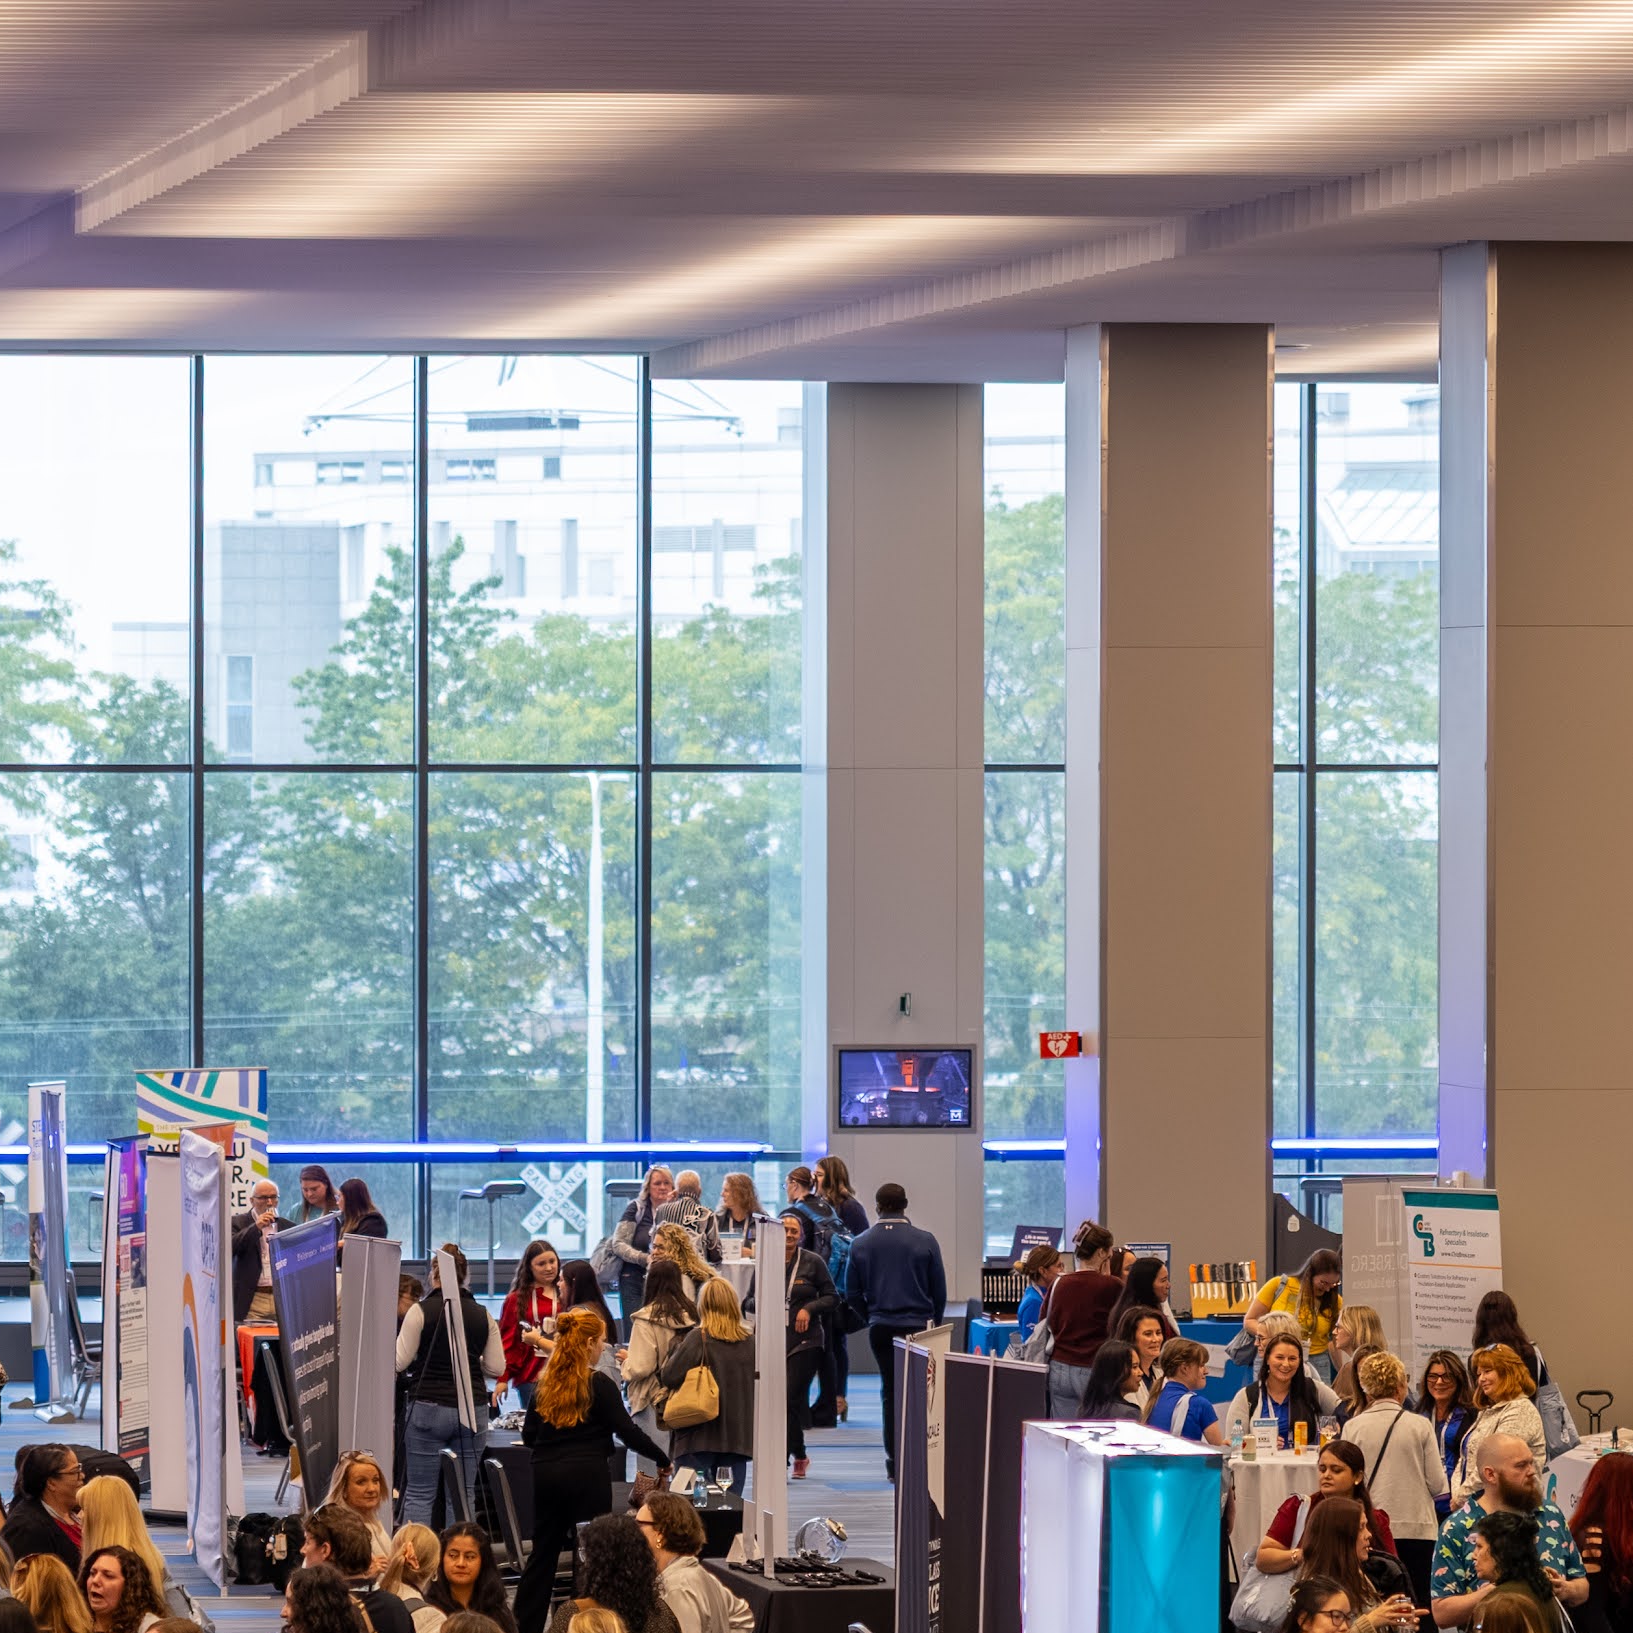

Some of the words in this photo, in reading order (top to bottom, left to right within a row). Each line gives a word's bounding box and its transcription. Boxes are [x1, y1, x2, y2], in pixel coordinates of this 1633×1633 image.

[526, 1168, 548, 1194] RAIL
[528, 1168, 585, 1227] CROSSING
[561, 1201, 586, 1228] ROAD
[1440, 1228, 1463, 1238] Refractory
[1467, 1229, 1489, 1238] Insulation
